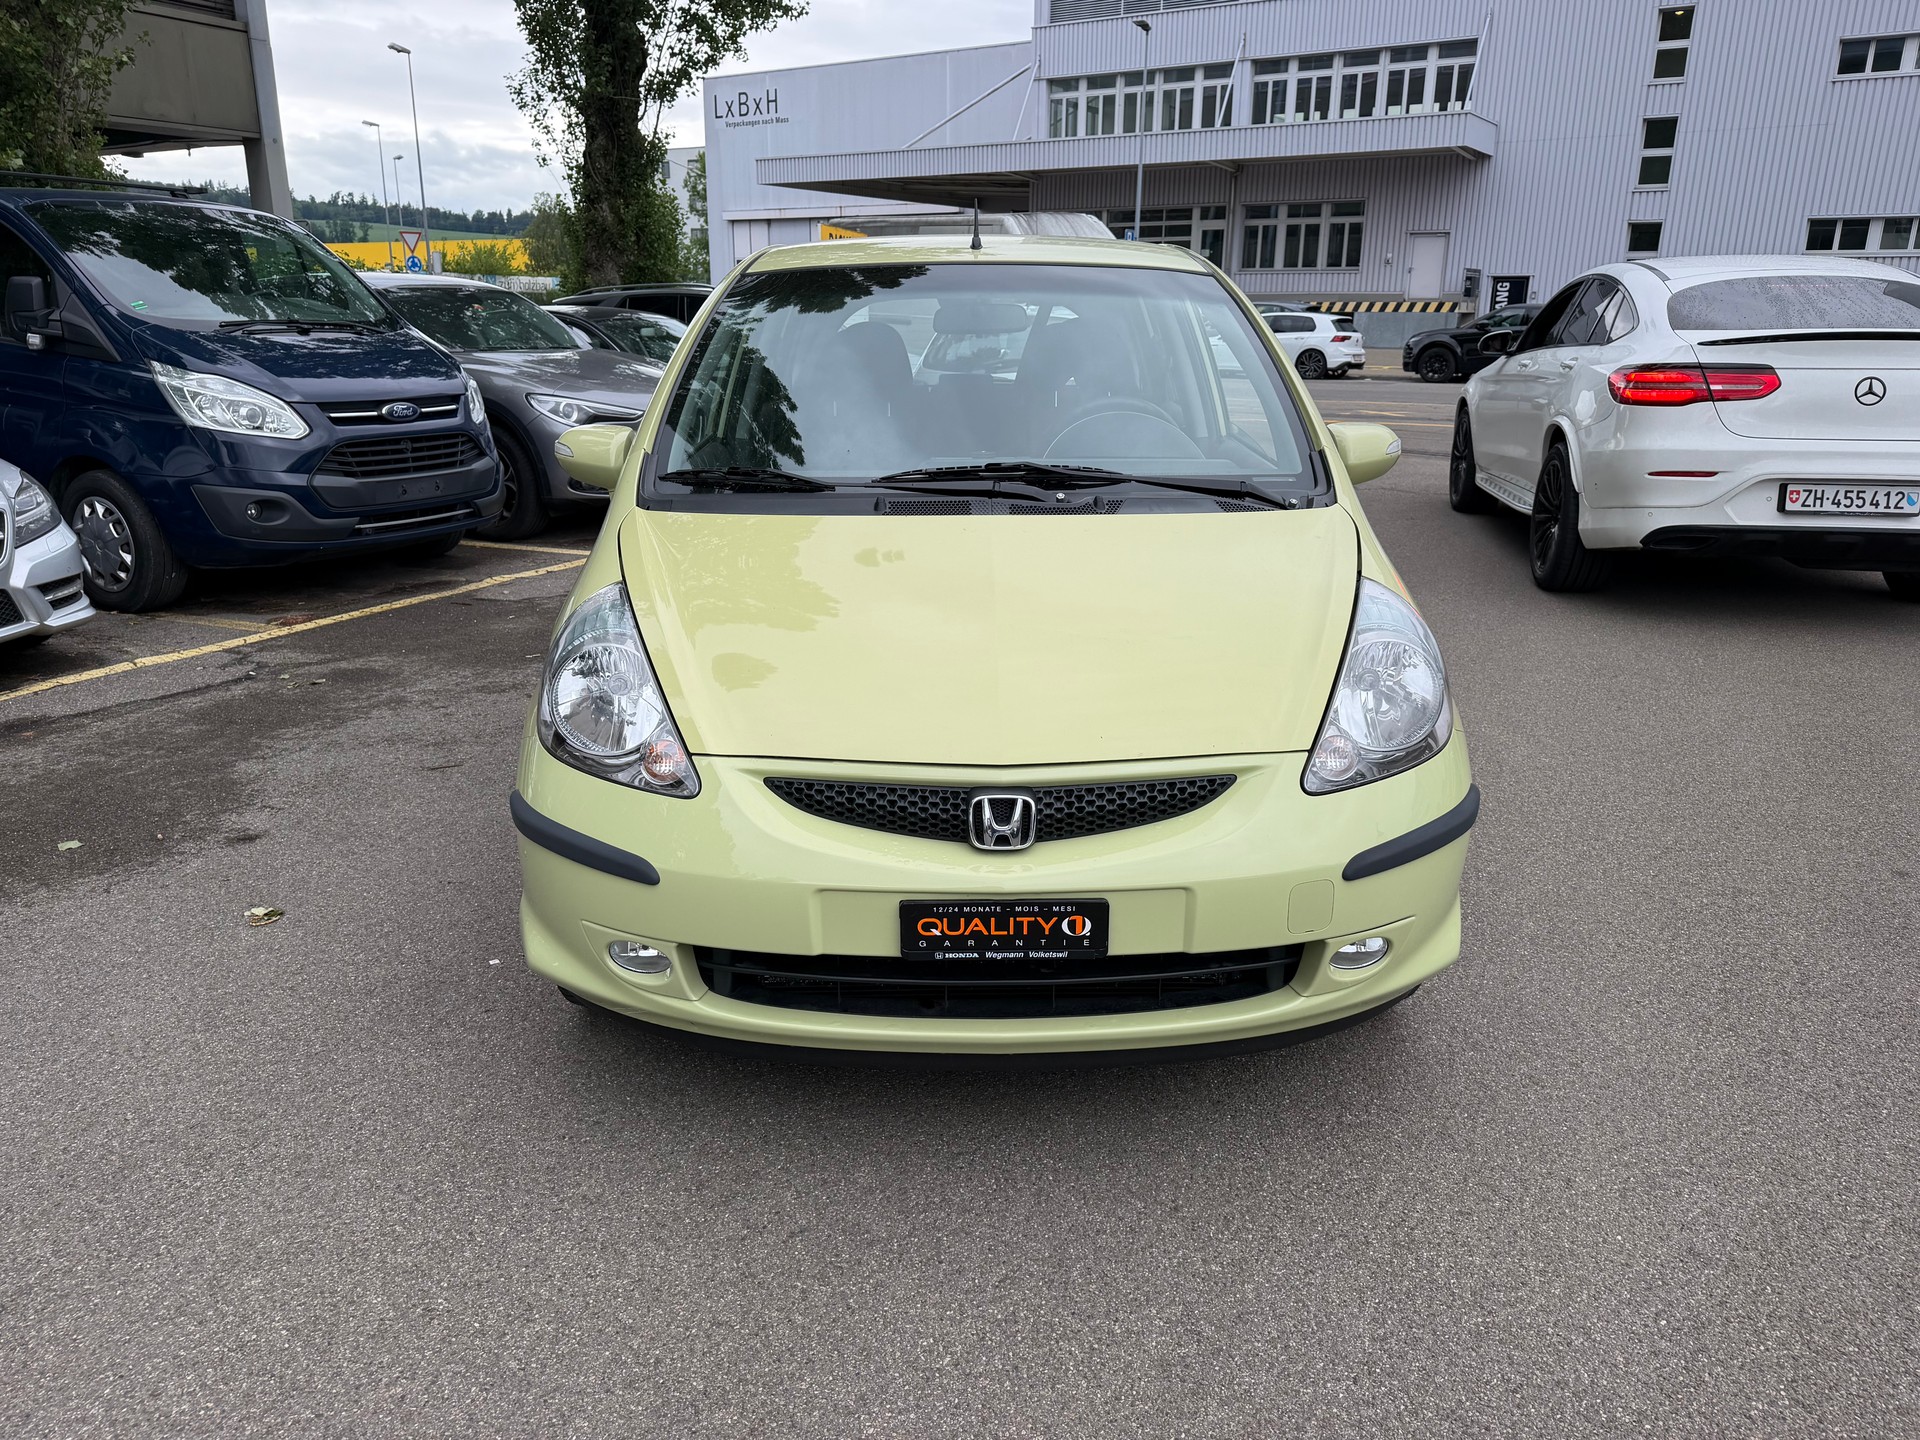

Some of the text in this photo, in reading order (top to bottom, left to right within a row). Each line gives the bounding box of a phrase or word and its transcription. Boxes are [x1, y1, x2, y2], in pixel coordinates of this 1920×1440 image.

[725, 116, 789, 129] Verpackungen nach Mass
[393, 404, 414, 417] Ford
[917, 917, 1058, 936] QUALITY
[919, 939, 1090, 948] GARANTIE
[985, 951, 1024, 960] Wegmann
